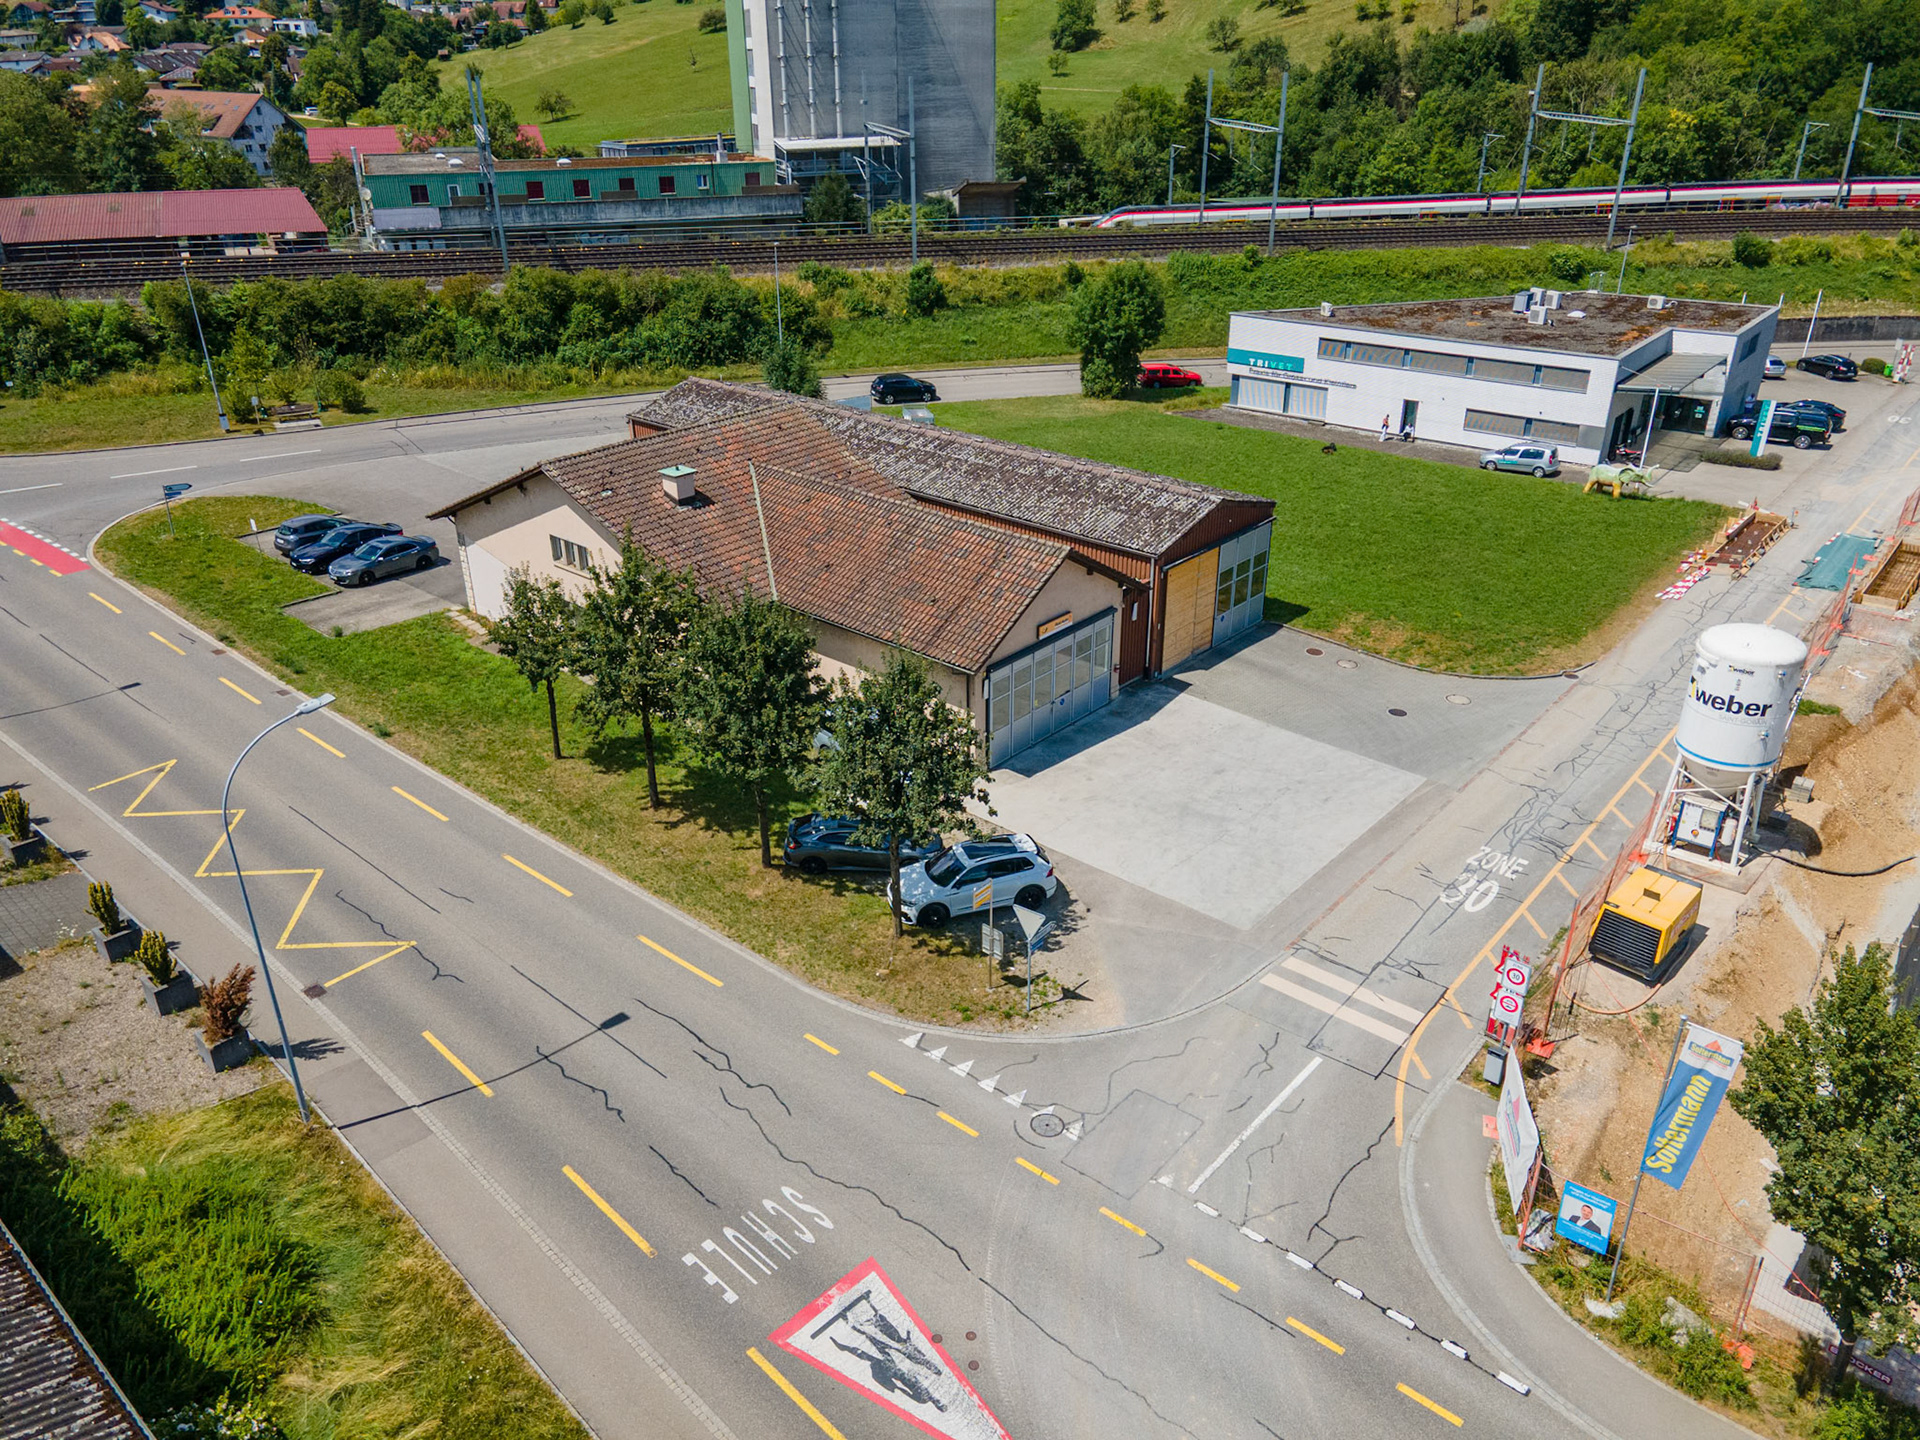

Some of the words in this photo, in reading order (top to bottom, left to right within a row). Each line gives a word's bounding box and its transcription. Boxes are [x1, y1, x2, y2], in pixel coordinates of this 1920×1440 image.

[1249, 359, 1293, 370] TRIVET
[1696, 689, 1772, 717] weber
[1466, 846, 1529, 880] ZONE
[1440, 872, 1499, 912] 30
[1511, 972, 1521, 981] 30
[1691, 1043, 1731, 1066] Soltermann
[1645, 1075, 1712, 1174] Soltermann
[681, 1186, 834, 1304] SCHULE
